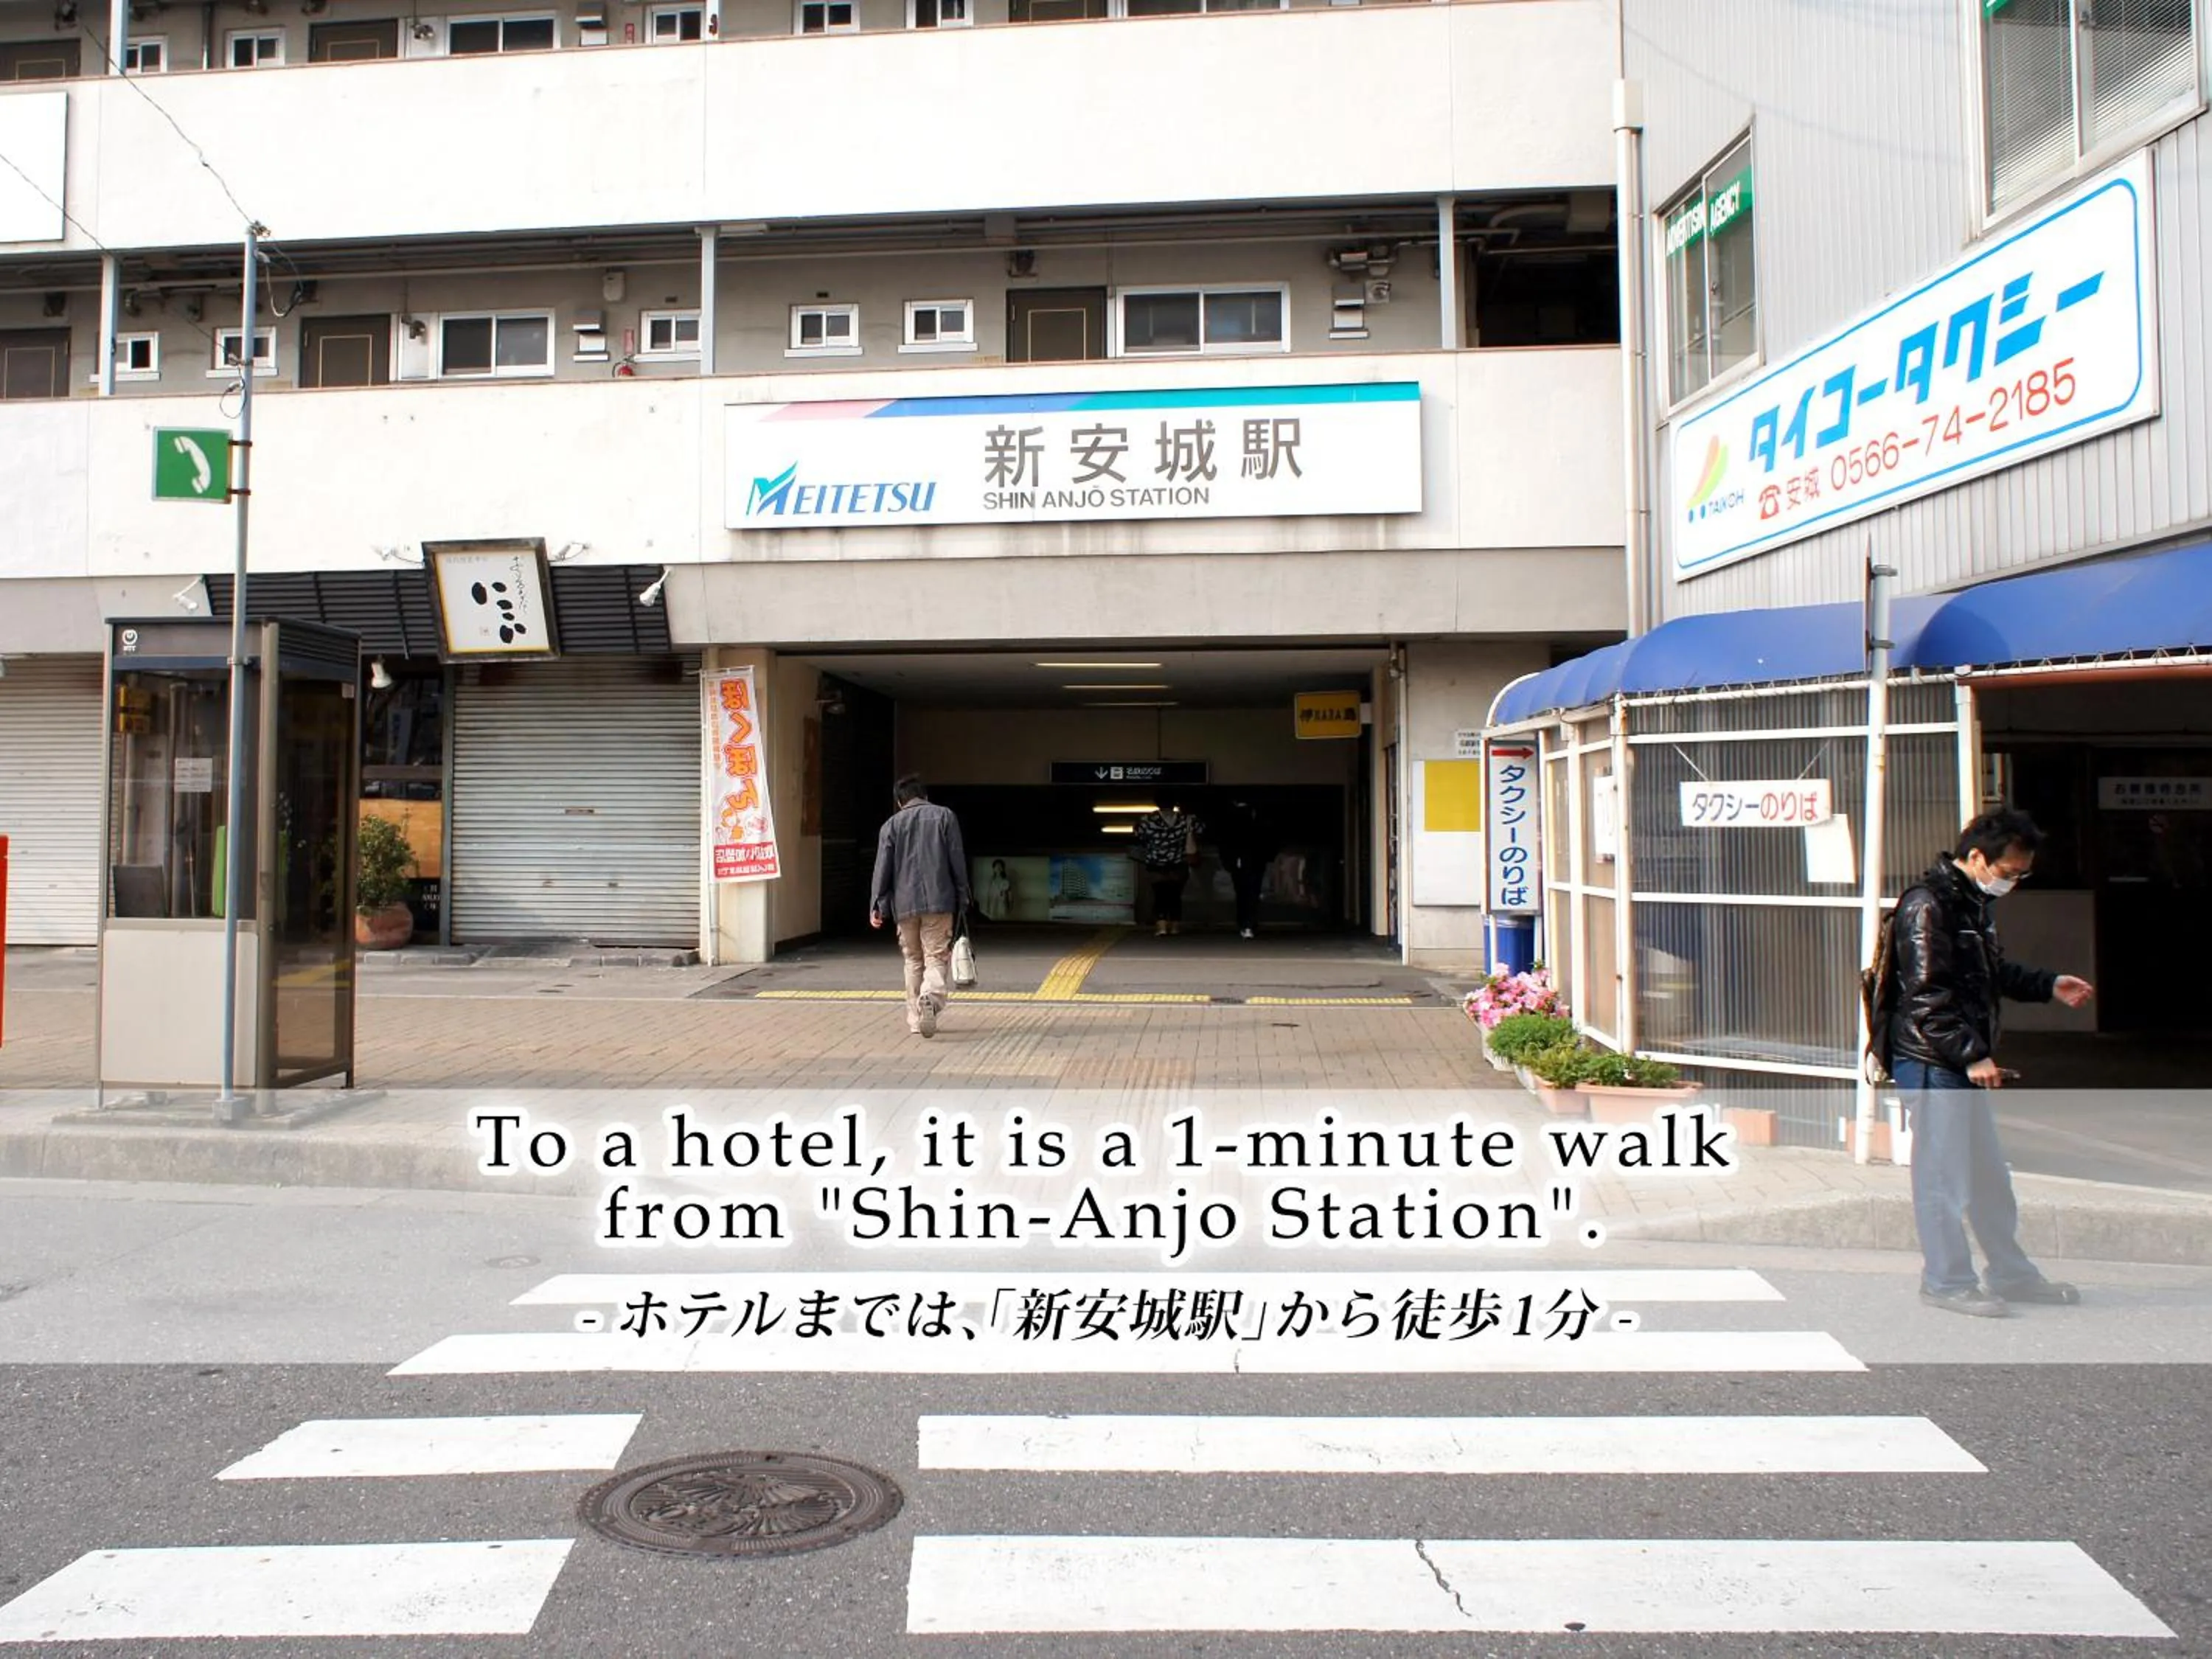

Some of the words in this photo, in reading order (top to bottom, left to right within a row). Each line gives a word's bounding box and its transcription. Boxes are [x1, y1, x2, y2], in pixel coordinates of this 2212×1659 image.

[1710, 180, 1739, 234] AGENCY
[1749, 271, 2104, 473] タイコータクシー
[984, 418, 1302, 487] 新安城駅
[1832, 358, 2076, 490] 0566-74-2185
[745, 460, 937, 516] MEITETSU
[983, 491, 1034, 509] SHIN
[1110, 487, 1209, 507] STATION
[1499, 764, 1529, 906] タクシーのりば
[1692, 791, 1818, 821] タクシーのりば
